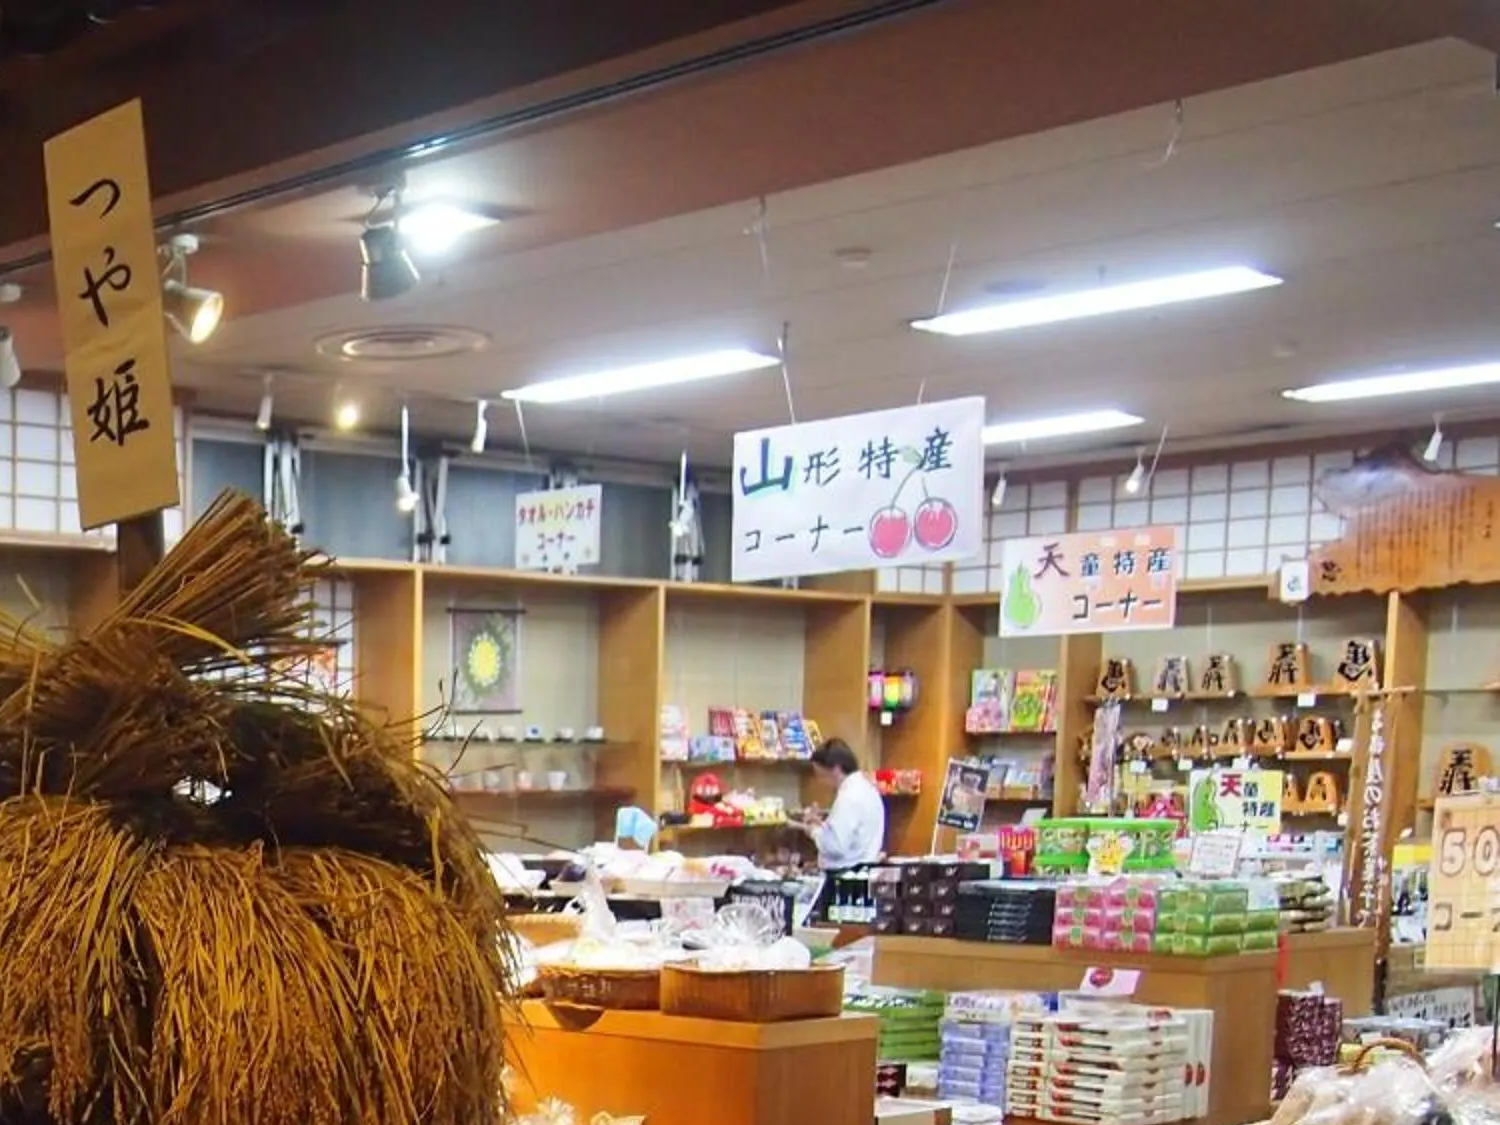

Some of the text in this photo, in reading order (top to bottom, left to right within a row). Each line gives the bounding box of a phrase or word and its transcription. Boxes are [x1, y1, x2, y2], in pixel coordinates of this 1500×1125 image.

[69, 177, 151, 447] つや姫
[739, 426, 954, 497] 山形特産
[744, 515, 864, 553] コーナー
[1033, 542, 1170, 579] 天童特産
[1072, 588, 1162, 621] コーナー
